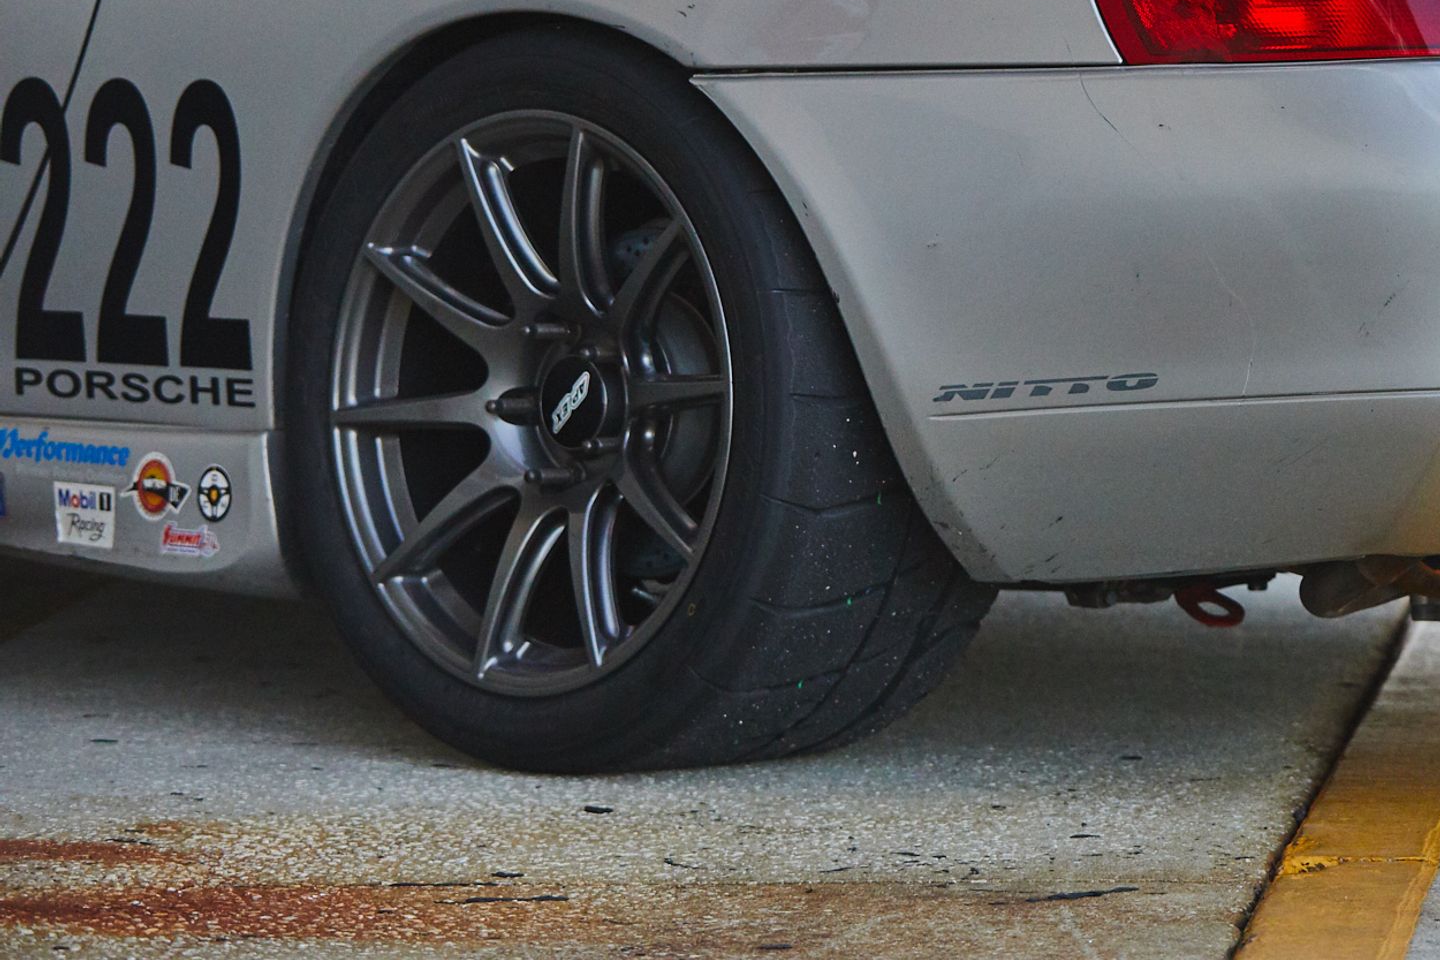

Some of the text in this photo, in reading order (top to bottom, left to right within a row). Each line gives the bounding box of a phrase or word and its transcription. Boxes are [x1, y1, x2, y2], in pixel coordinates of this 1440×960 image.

[0, 76, 253, 371] 222
[14, 366, 256, 408] PORSCHE
[932, 372, 1159, 402] NITTO
[58, 488, 97, 510] Mobil
[66, 512, 106, 542] Racing
